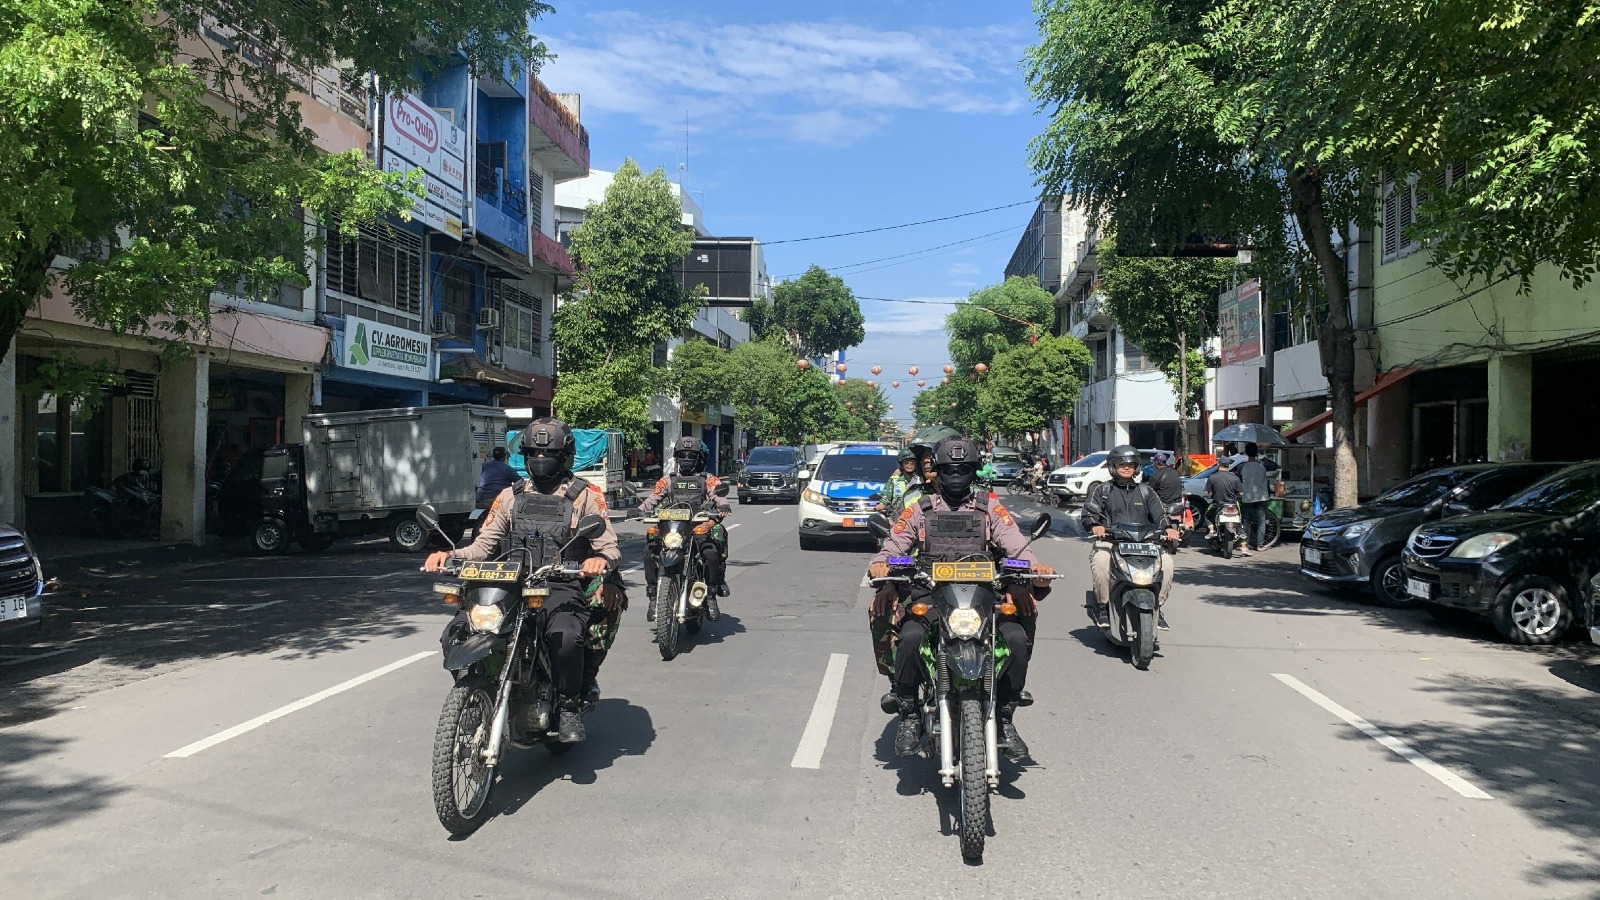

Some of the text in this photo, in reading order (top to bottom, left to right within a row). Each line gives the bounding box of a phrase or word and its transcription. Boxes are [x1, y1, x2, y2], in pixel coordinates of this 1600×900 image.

[397, 104, 434, 144] Pro-Quip
[372, 330, 428, 355] CV. AGROMESIN
